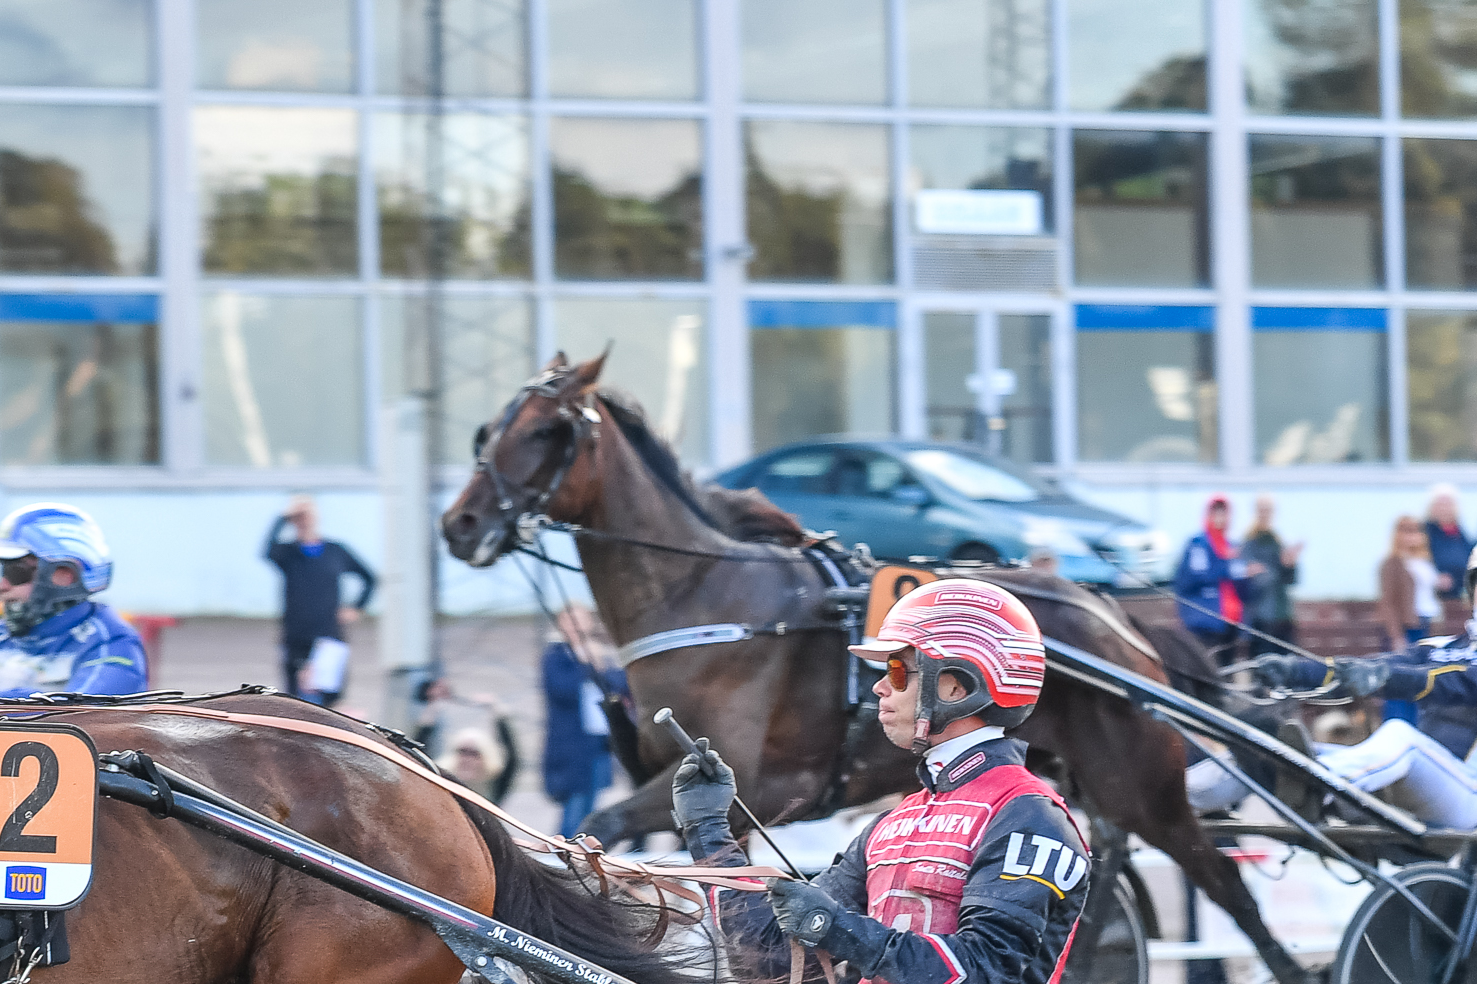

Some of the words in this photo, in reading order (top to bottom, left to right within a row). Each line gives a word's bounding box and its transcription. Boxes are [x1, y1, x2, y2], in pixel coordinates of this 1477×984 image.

[9, 872, 43, 893] TOTO
[1002, 831, 1087, 892] LTU
[487, 926, 509, 944] M.
[510, 932, 574, 972] Nieminen
